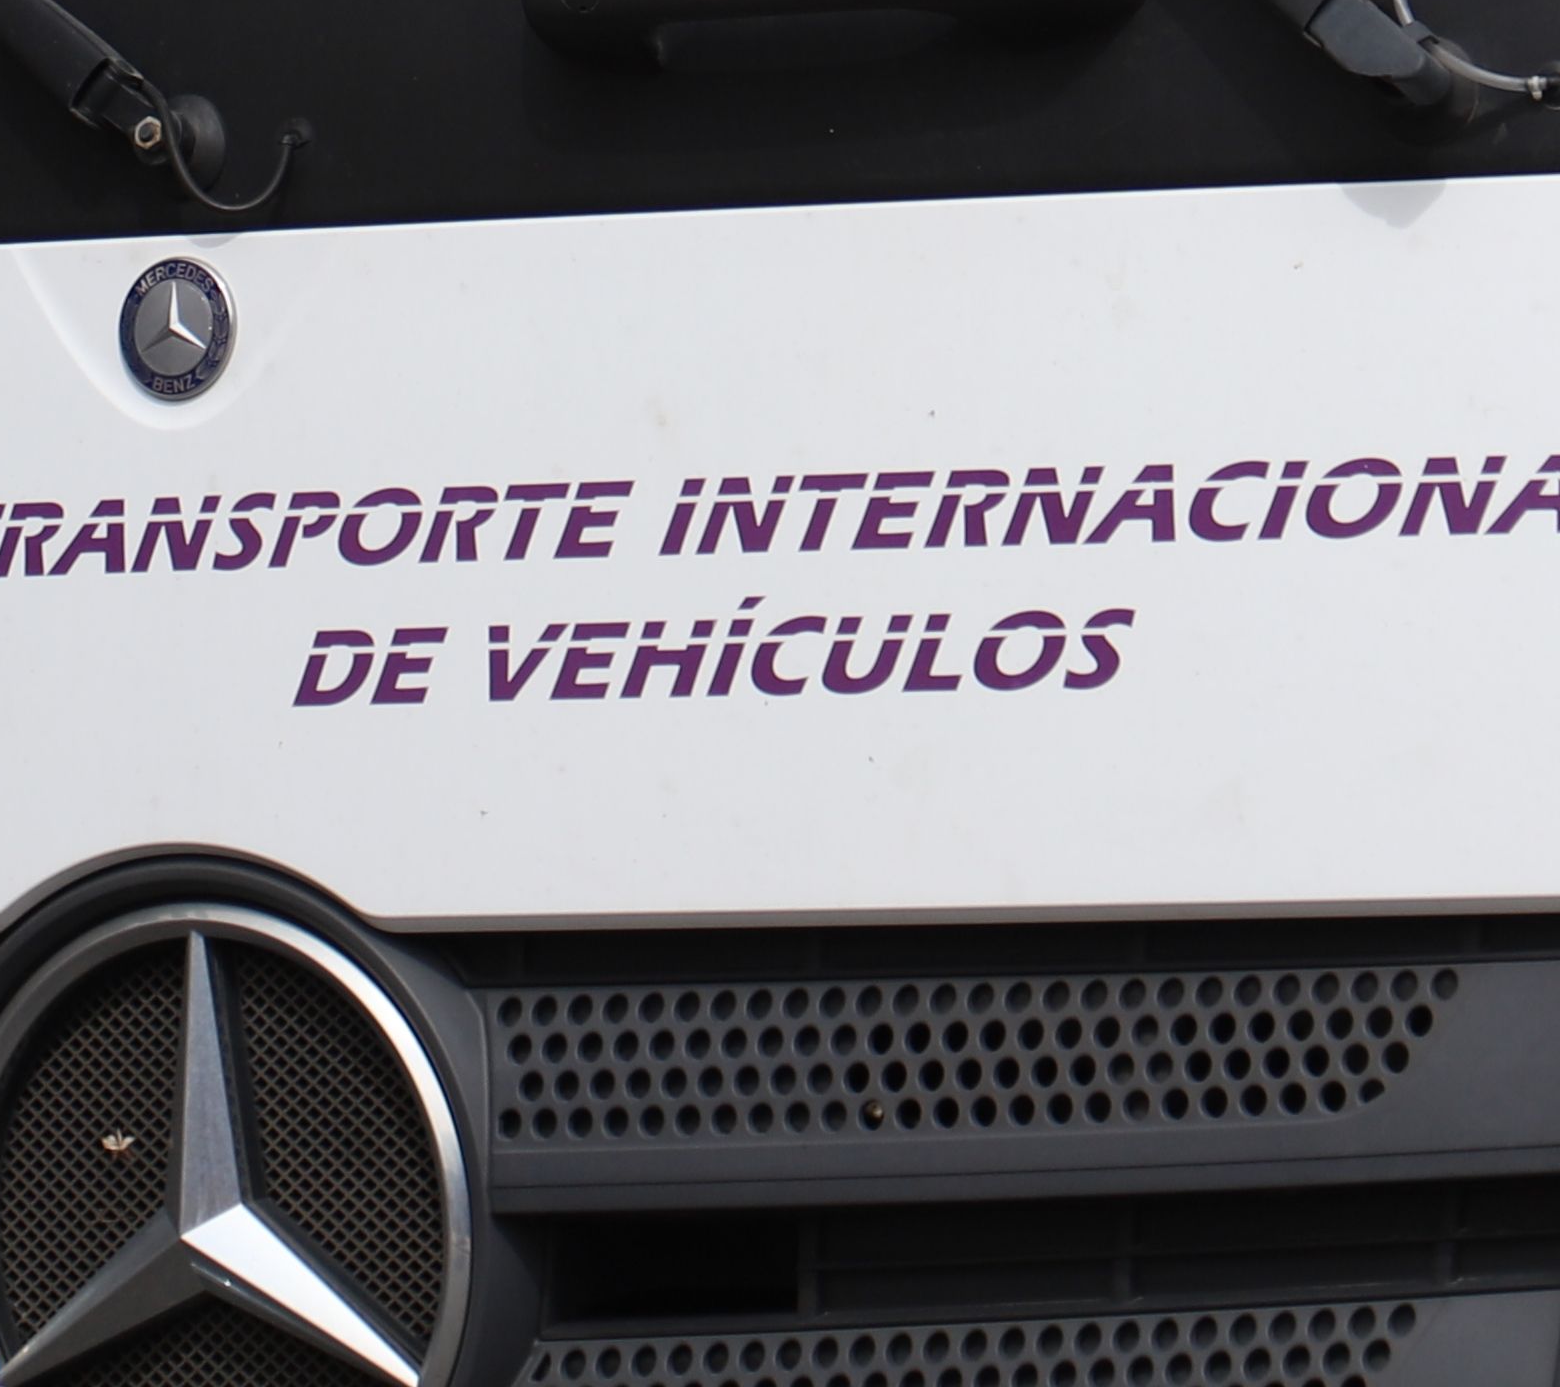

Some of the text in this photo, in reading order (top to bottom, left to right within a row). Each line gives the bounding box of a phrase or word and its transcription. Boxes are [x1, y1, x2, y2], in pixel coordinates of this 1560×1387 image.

[135, 262, 214, 297] MERCEDES
[152, 374, 197, 394] BENZ
[292, 596, 1136, 707] DE VEHÍCULOS
